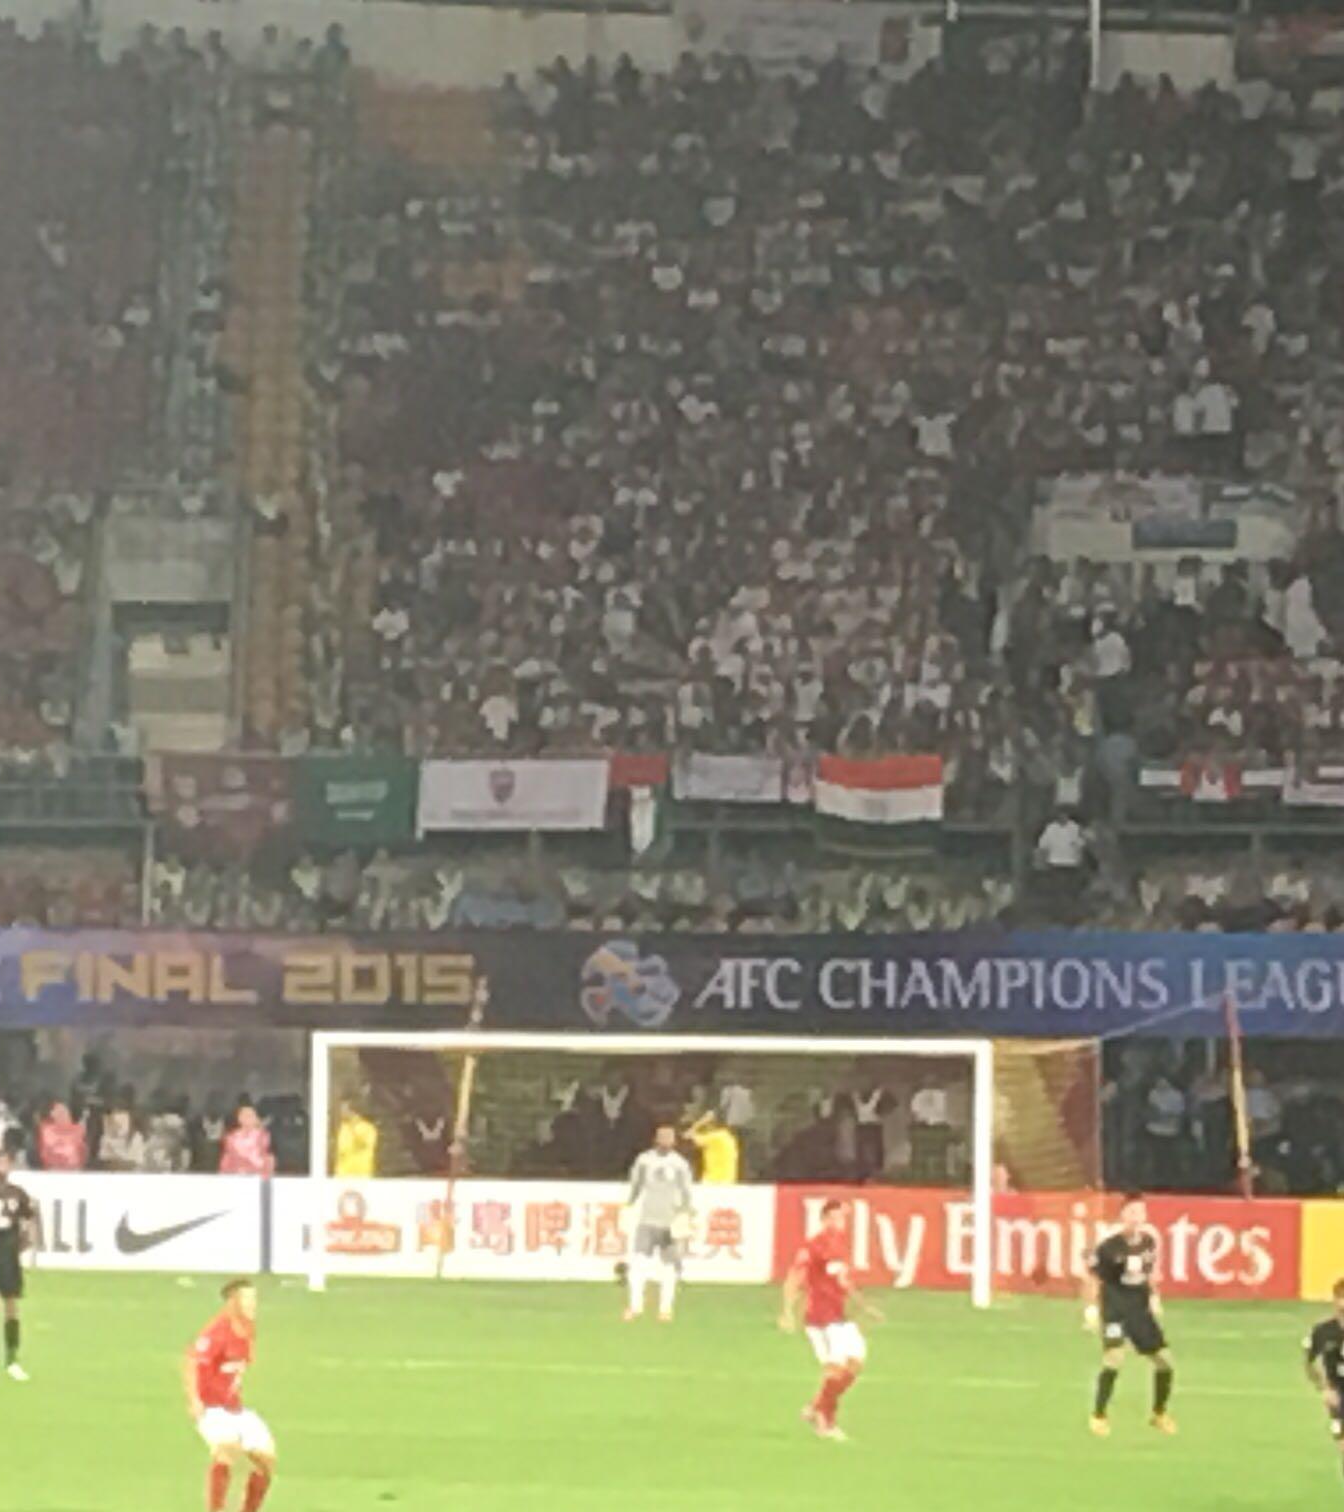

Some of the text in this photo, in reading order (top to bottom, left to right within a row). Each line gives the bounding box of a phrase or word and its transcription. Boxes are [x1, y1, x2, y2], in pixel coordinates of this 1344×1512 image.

[21, 952, 259, 1002] FINAL
[283, 952, 476, 1006] 2015
[693, 958, 804, 1009] AFC
[818, 957, 1168, 1011] CHAMPIONS
